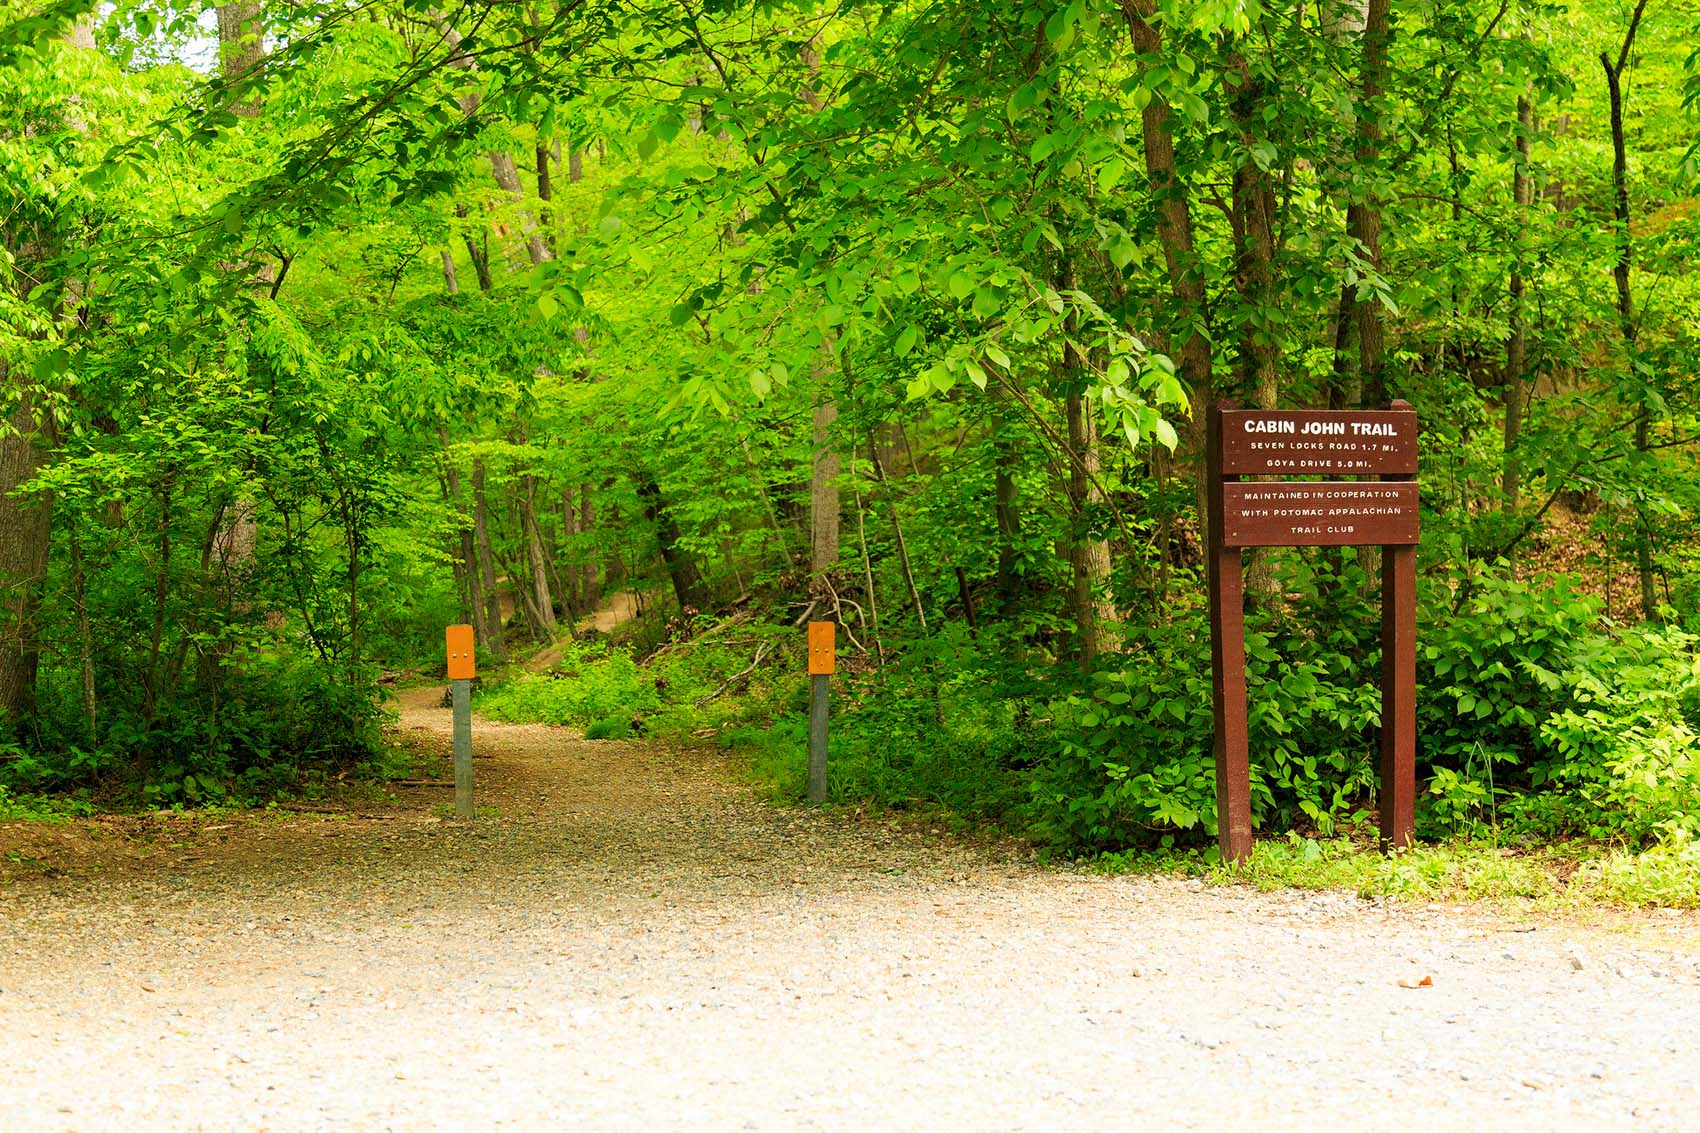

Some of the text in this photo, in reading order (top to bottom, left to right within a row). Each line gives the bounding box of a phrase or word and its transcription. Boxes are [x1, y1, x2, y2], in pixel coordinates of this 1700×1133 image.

[1244, 420, 1397, 436] CABIN JOHN TRAIL
[1251, 442, 1284, 450] SEVEN
[1290, 442, 1324, 450] LOCKS
[1244, 492, 1309, 500] MAINTAINED
[1327, 491, 1399, 499] COOPERATION
[1328, 507, 1401, 515] APPALACHIAN
